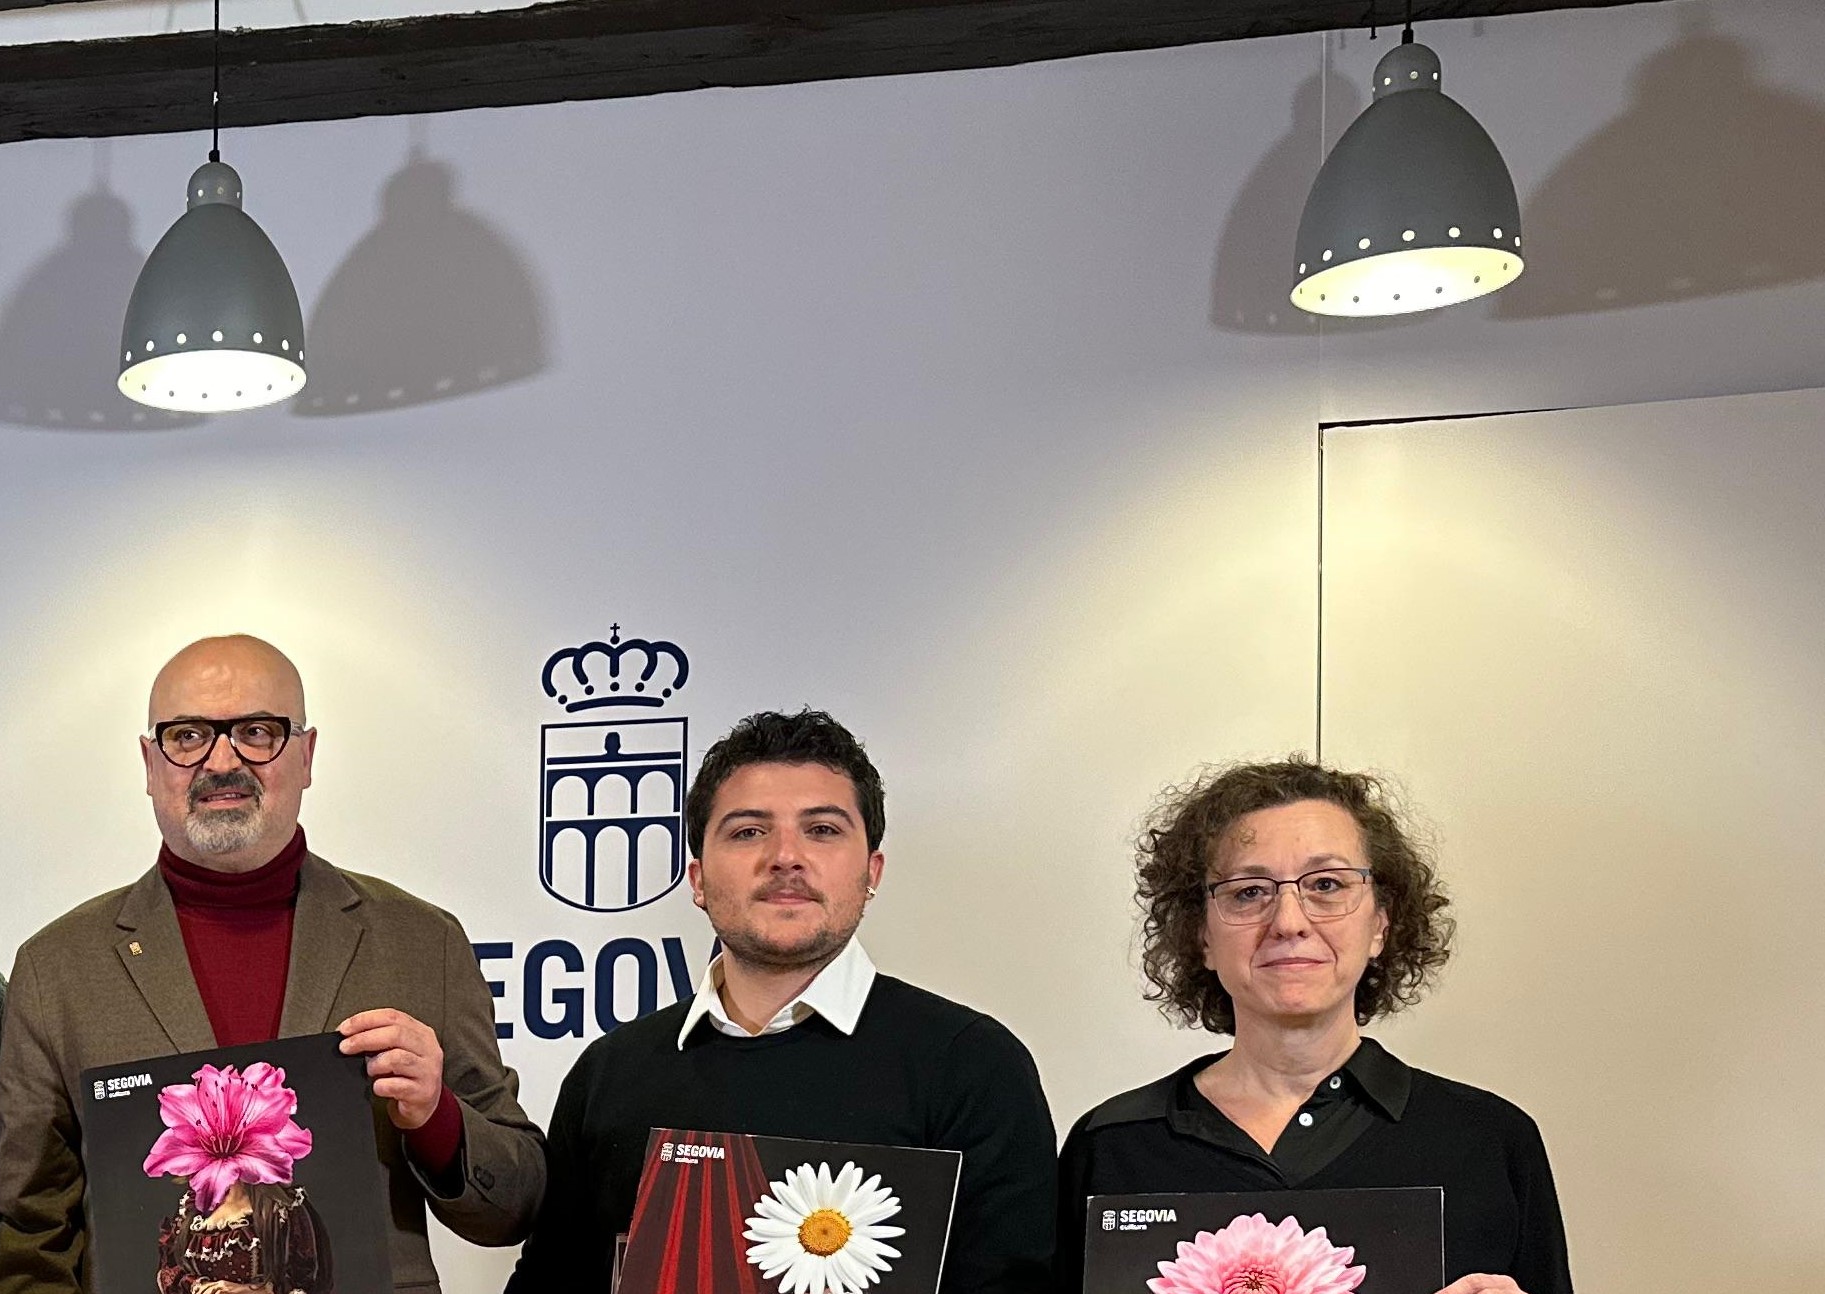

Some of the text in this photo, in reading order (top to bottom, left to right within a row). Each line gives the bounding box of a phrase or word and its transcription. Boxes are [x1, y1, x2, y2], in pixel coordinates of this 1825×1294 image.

[470, 936, 722, 1040] EGOV
[107, 1073, 152, 1091] SEGOVIA
[676, 1143, 724, 1159] SEGOVIA
[1119, 1209, 1177, 1222] SEGOVIA
